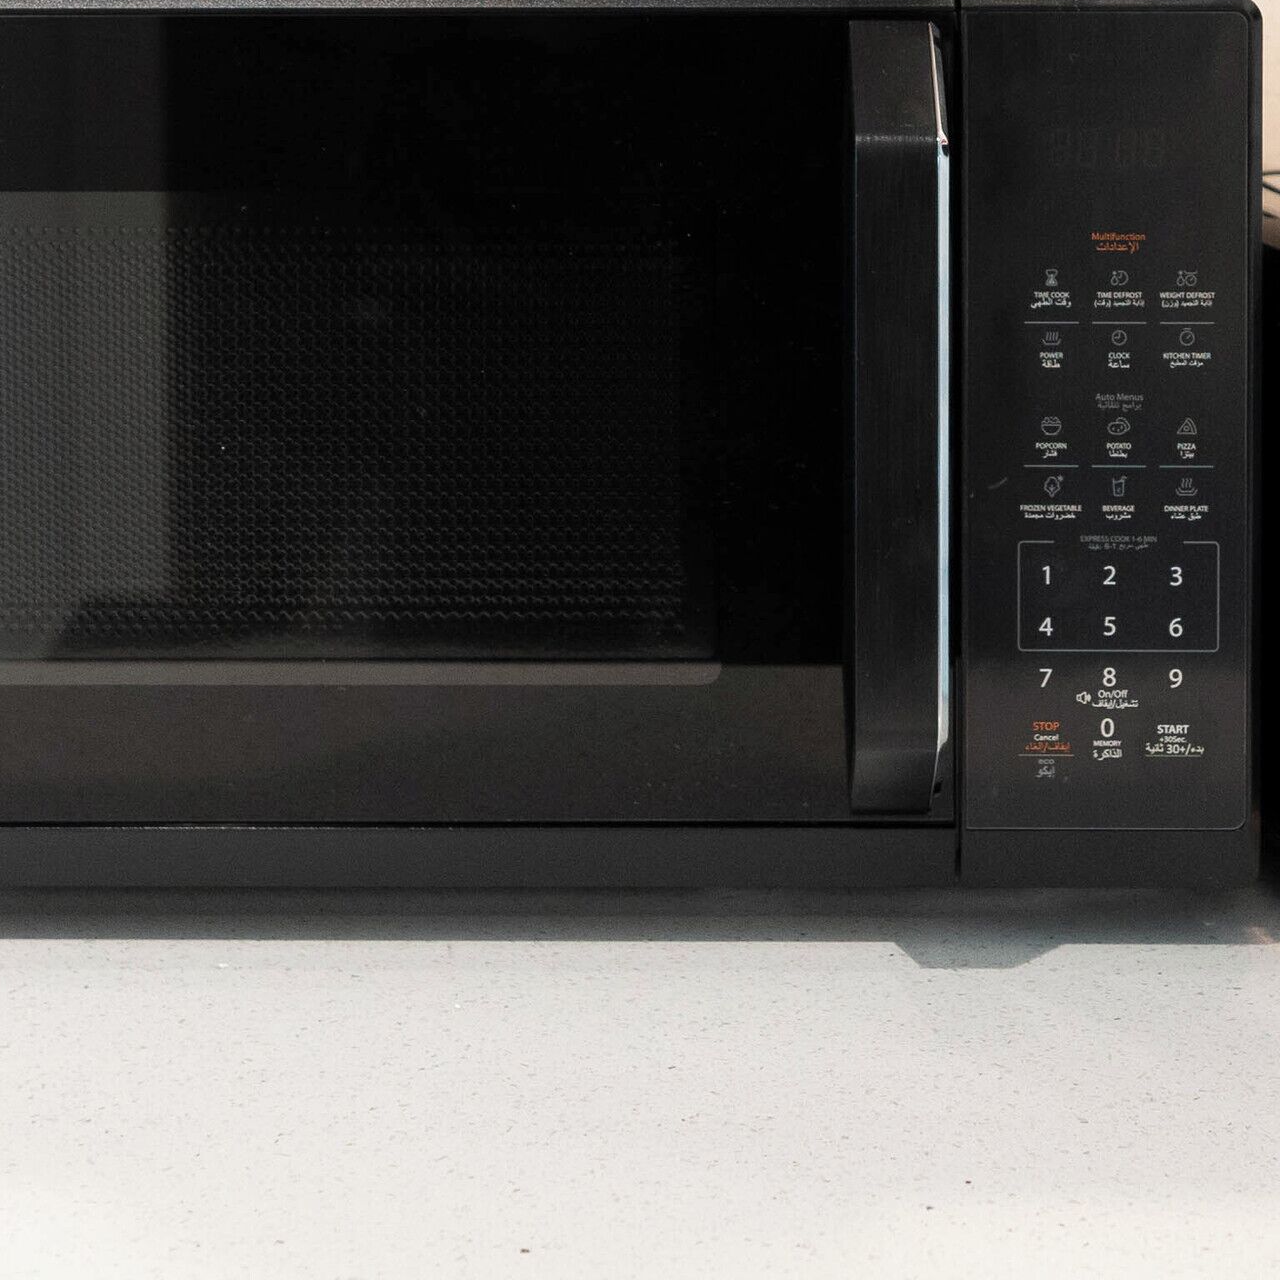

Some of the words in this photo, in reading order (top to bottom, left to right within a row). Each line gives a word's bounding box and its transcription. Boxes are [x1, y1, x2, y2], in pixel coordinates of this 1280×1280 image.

[1091, 233, 1146, 241] Multifunction
[1095, 393, 1114, 401] Auto
[1116, 393, 1144, 401] Menus
[1042, 566, 1051, 585] 1
[1103, 566, 1116, 585] 2
[1170, 567, 1183, 586] 3
[1038, 617, 1053, 636] 4
[1103, 616, 1116, 636] 5
[1169, 618, 1183, 637] 6
[1039, 669, 1053, 687] 7
[1103, 668, 1116, 687] 8
[1169, 669, 1183, 688] 9
[1098, 690, 1128, 699] On/Off
[1032, 721, 1060, 731] STOP
[1100, 718, 1114, 737] 0
[1157, 724, 1189, 734] START
[1034, 733, 1059, 742] Cancel
